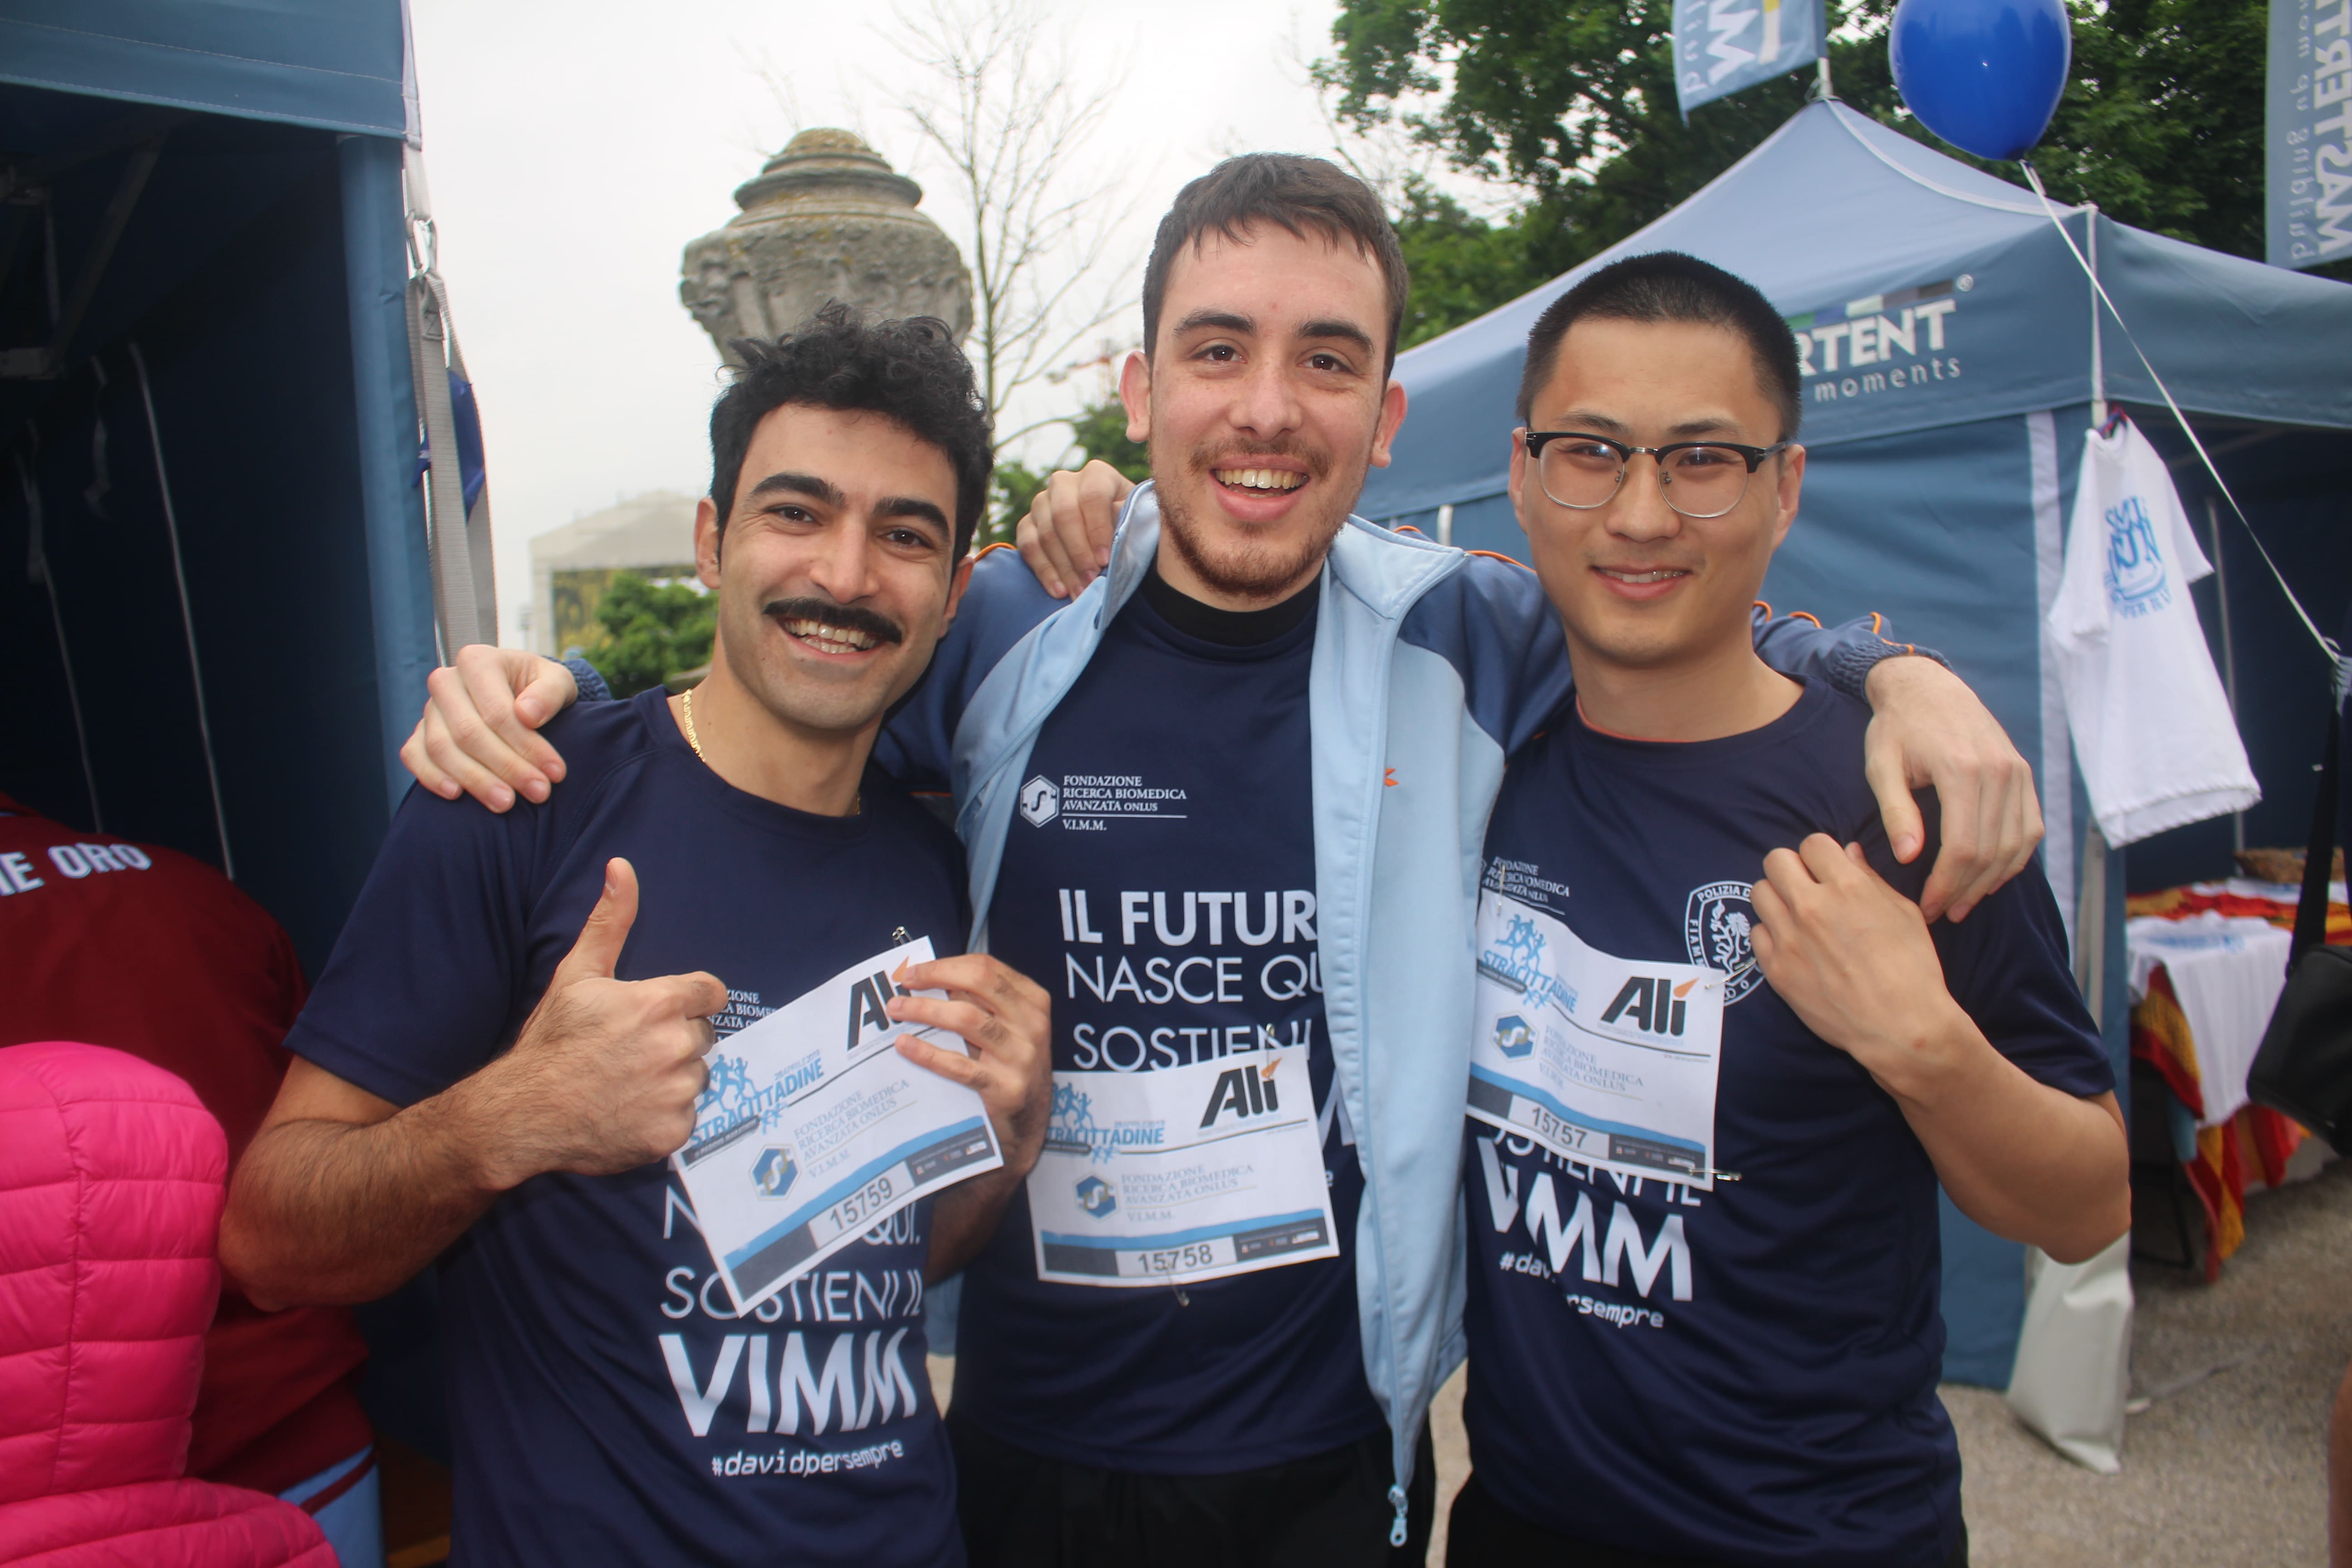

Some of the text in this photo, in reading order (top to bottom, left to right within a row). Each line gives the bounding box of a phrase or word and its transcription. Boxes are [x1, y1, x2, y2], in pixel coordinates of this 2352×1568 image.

[1796, 299, 1956, 377] RTENT
[1815, 357, 1961, 402] moments
[1062, 788, 1187, 800] RICERCA BIOMEDICA
[1063, 775, 1143, 787] FONDAZIONE
[1062, 800, 1158, 812] AVANZATA ONLUS
[1062, 819, 1107, 831] V.I.M.M.
[47, 842, 152, 879] ORO
[1696, 884, 1741, 902] POLIZIA
[1059, 889, 1318, 947] IL FUTUR
[1066, 952, 1244, 1004] NASCE
[690, 1057, 824, 1149] STRACITTADINE
[794, 1090, 864, 1140] FONDAZIONE
[845, 1078, 910, 1122] BIOMEDICA
[1047, 1119, 1165, 1146] TRACITTADINE
[1532, 1106, 1588, 1149] 15757
[830, 1176, 892, 1230] 15759
[1138, 1244, 1213, 1274] 15758
[658, 1327, 918, 1438] VIMM
[710, 1439, 904, 1478] #davidpersempre
